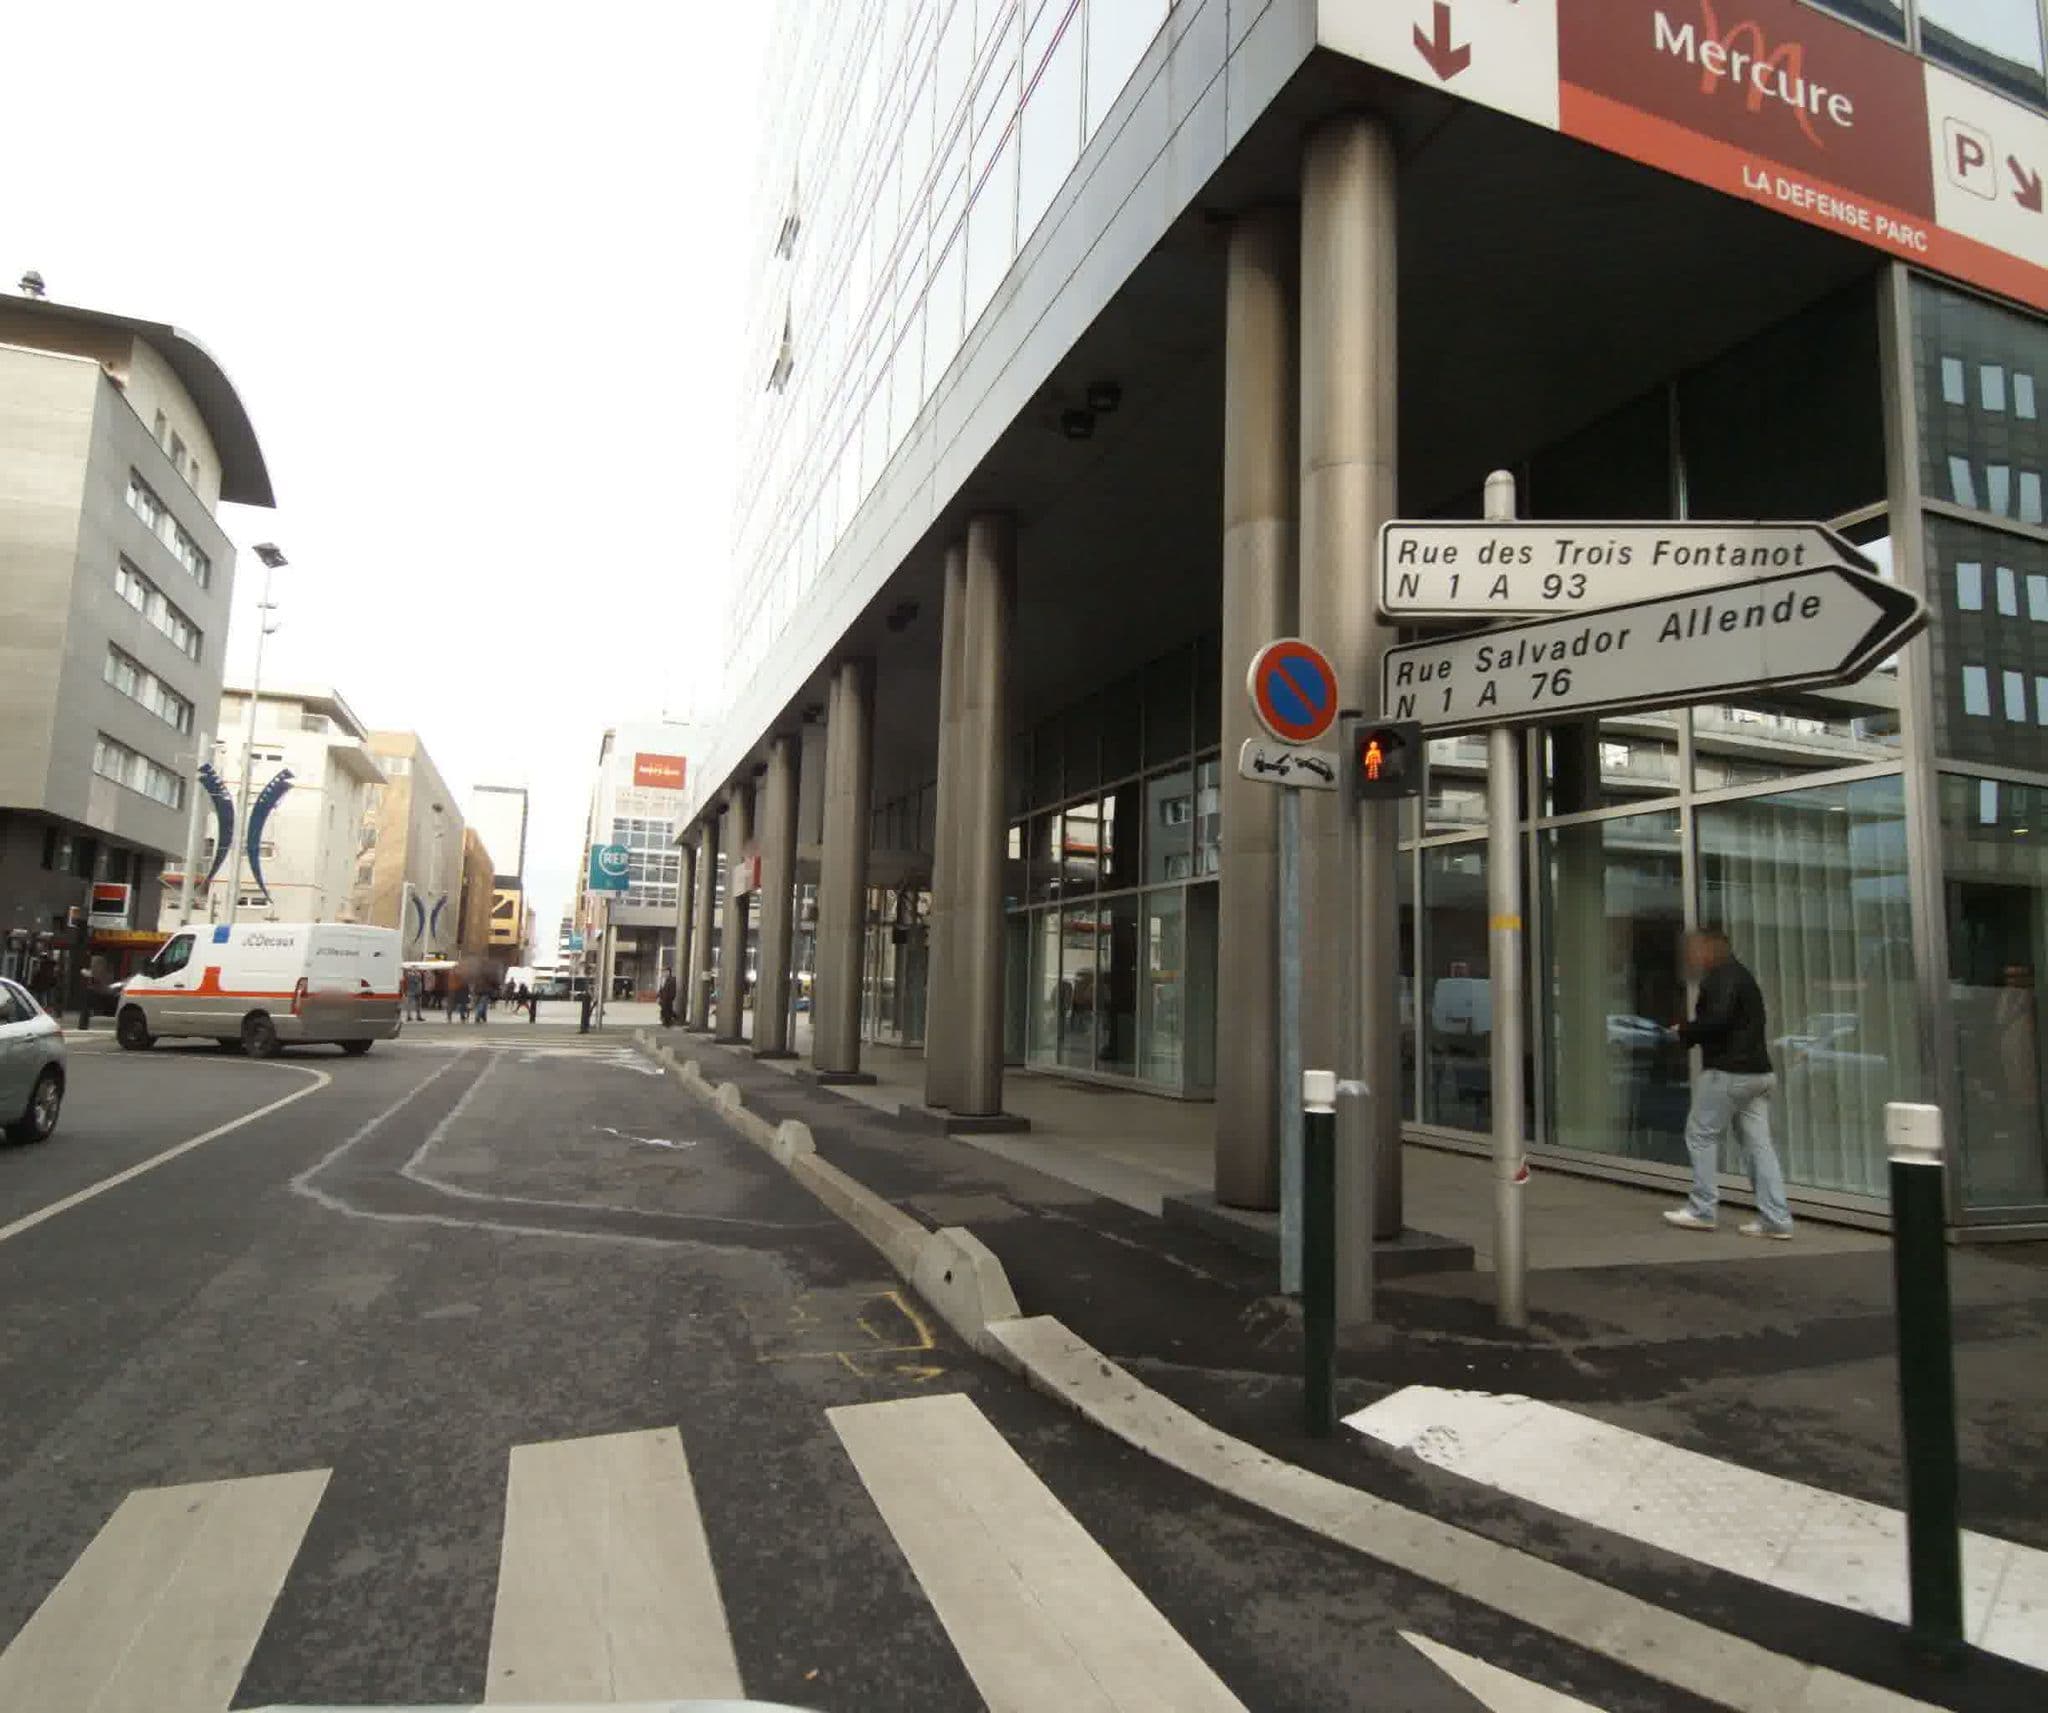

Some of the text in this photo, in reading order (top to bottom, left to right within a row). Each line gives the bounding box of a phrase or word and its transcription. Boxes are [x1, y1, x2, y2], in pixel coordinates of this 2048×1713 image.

[1653, 10, 1854, 127] Mercure
[1955, 133, 1985, 177] P
[1742, 164, 1929, 252] LA DEFENSE PARC
[1398, 539, 1806, 567] Rue des Trois Fontanot
[1398, 573, 1587, 599] N 1 A 93
[1396, 591, 1822, 687] Rue Salvador Allende
[1396, 668, 1573, 720] N 1 A 76
